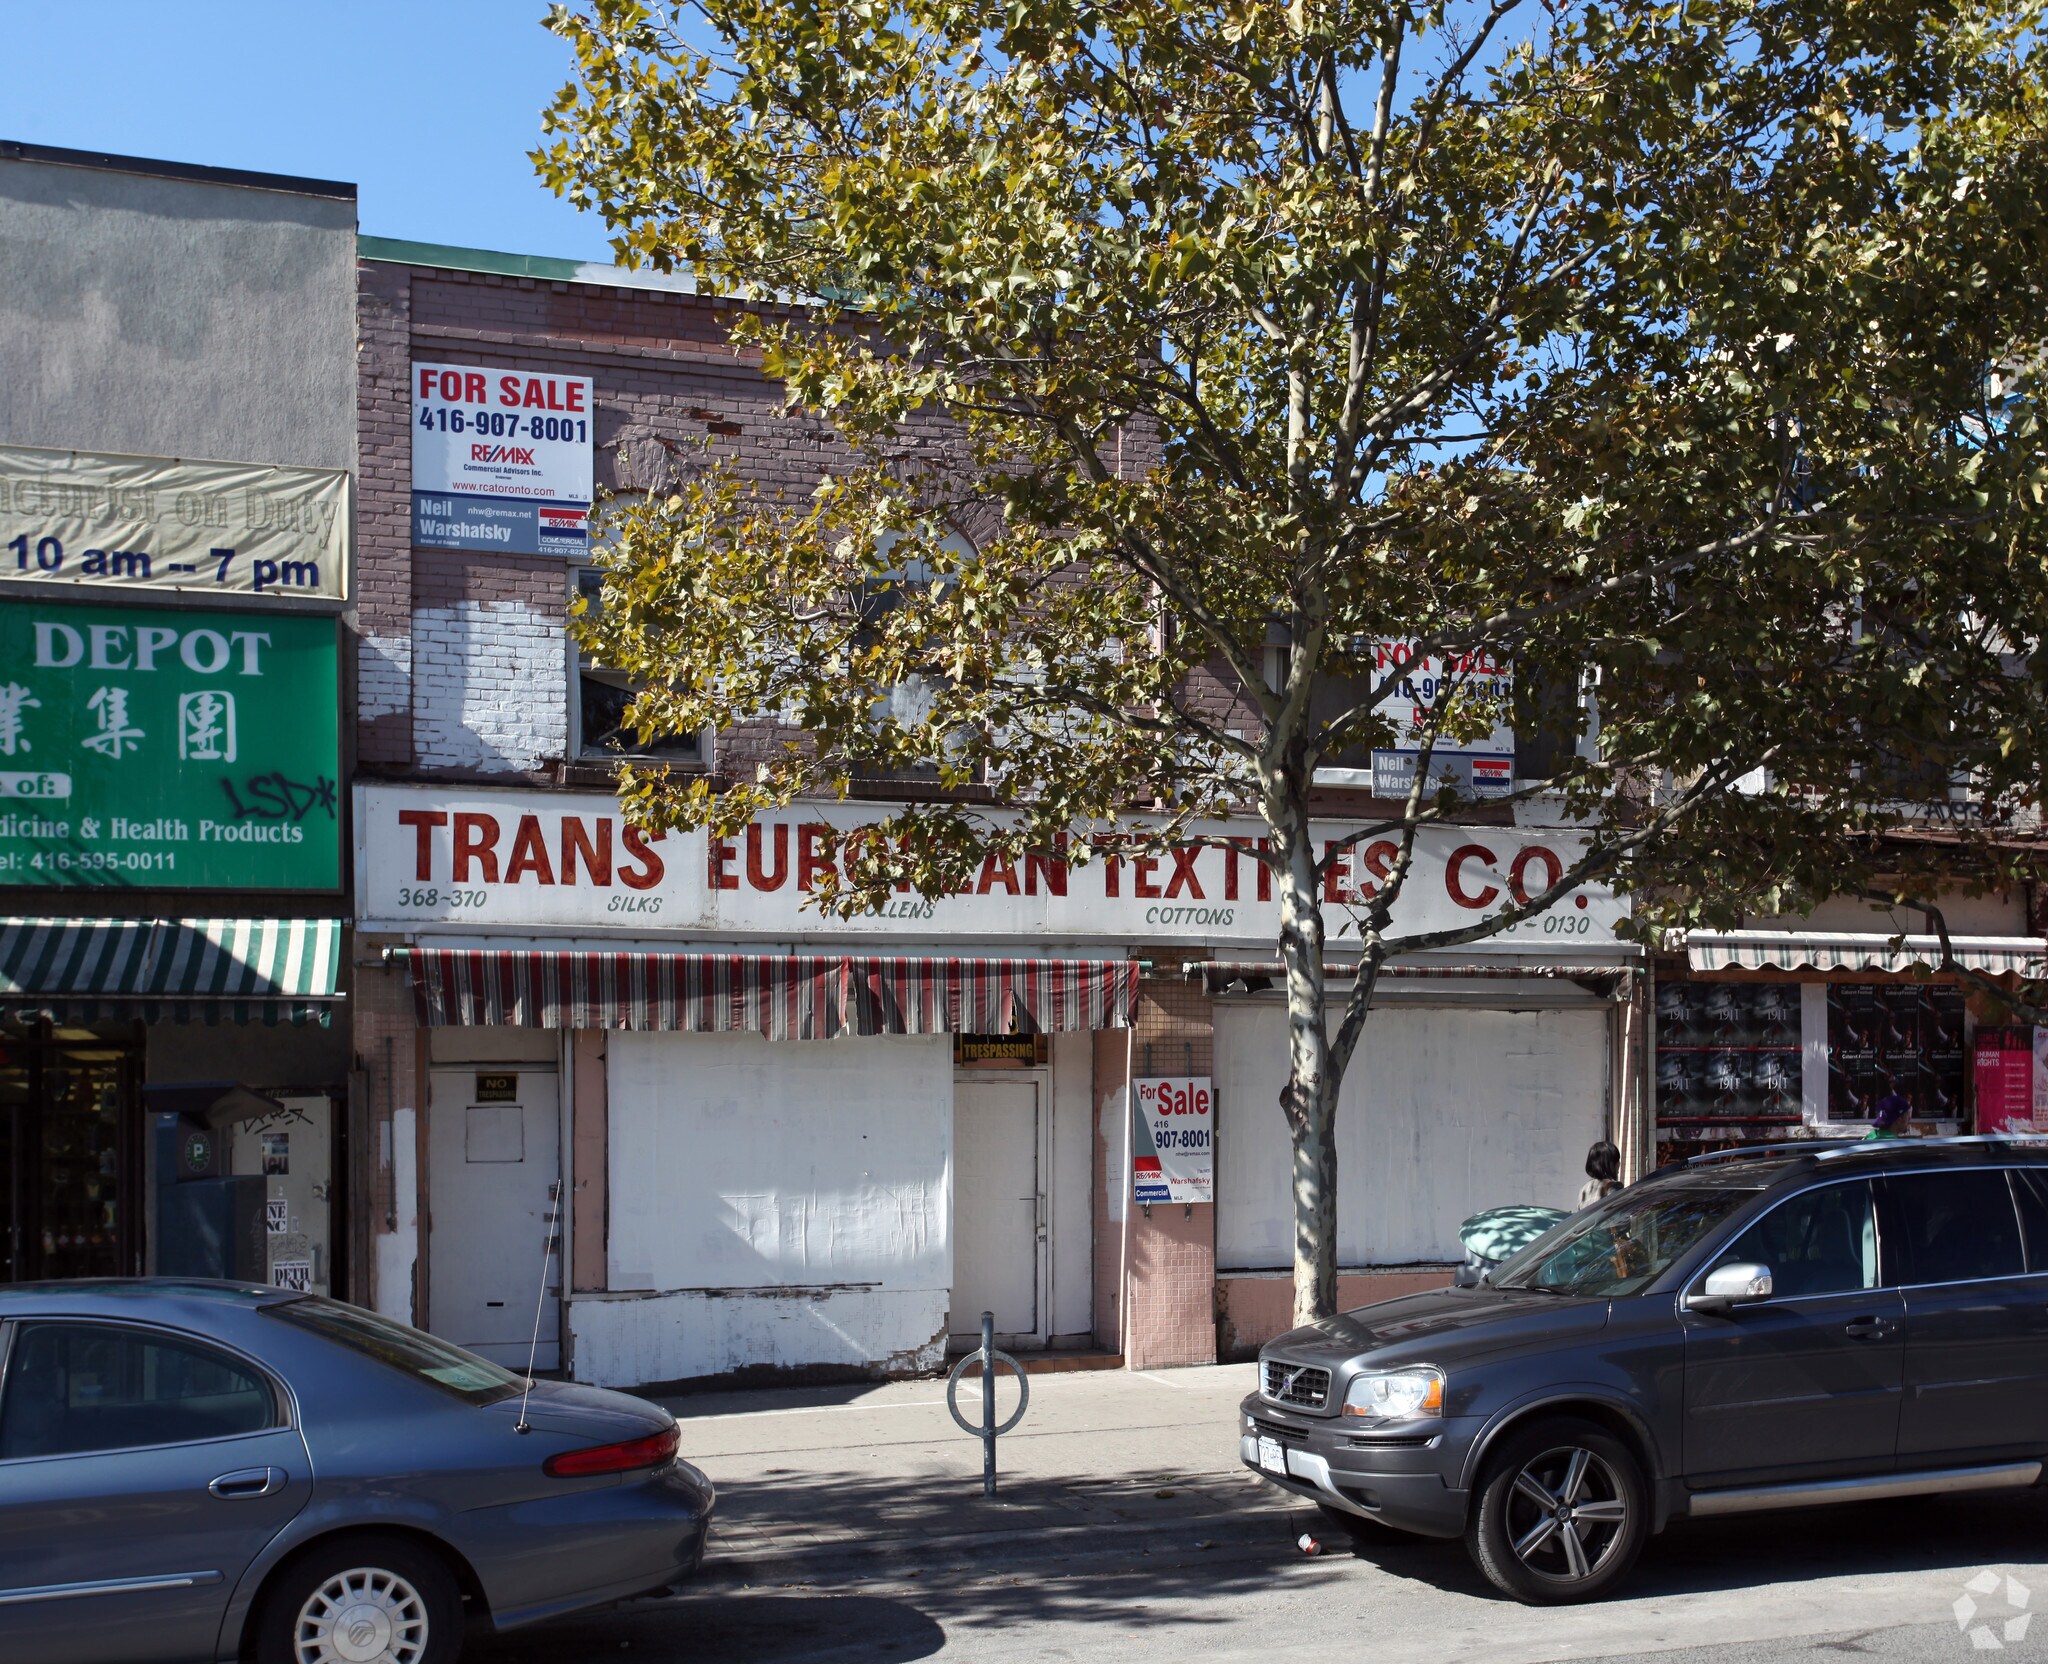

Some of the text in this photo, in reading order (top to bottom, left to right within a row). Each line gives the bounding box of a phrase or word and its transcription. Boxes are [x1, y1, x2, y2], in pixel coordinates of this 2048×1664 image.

[420, 369, 585, 413] FOR SALE
[420, 407, 587, 443] 416-907-8001
[471, 444, 535, 465] RE/MAX
[463, 464, 502, 474] Commercial
[503, 467, 530, 476] Advisors
[452, 481, 555, 497] www.rcatoronto.com
[176, 490, 228, 528] on
[246, 486, 340, 549] Duty
[420, 499, 452, 516] Neil
[467, 507, 532, 519] nhw@remax.net
[420, 519, 512, 542] Warshafsky
[8, 534, 63, 572] 10
[81, 549, 151, 578] am
[210, 548, 236, 582] 7
[253, 559, 319, 592] pm
[32, 622, 271, 676] DEPOT
[1379, 757, 1404, 771] Neil
[16, 775, 56, 795] of:
[1379, 774, 1449, 792] Warsfs
[80, 817, 100, 839] &
[111, 817, 188, 840] Health
[199, 820, 304, 843] Products
[30, 852, 175, 869] 416-595-0011
[399, 810, 1588, 909] TRANS EUROAN TEXTIES CO.
[398, 887, 488, 908] 368-370
[606, 894, 663, 913] SILKS
[1145, 906, 1235, 926] COTTONS
[1481, 914, 1590, 934] 5-0130
[964, 1044, 1033, 1058] TRESPASSING
[1977, 1059, 2000, 1067] RIGHTS
[486, 1079, 507, 1088] NO
[1140, 1082, 1209, 1116] For Sale
[1154, 1120, 1169, 1128] 416
[1155, 1129, 1210, 1149] 907-8001
[193, 1143, 204, 1157] P
[1136, 1189, 1168, 1197] Commercial
